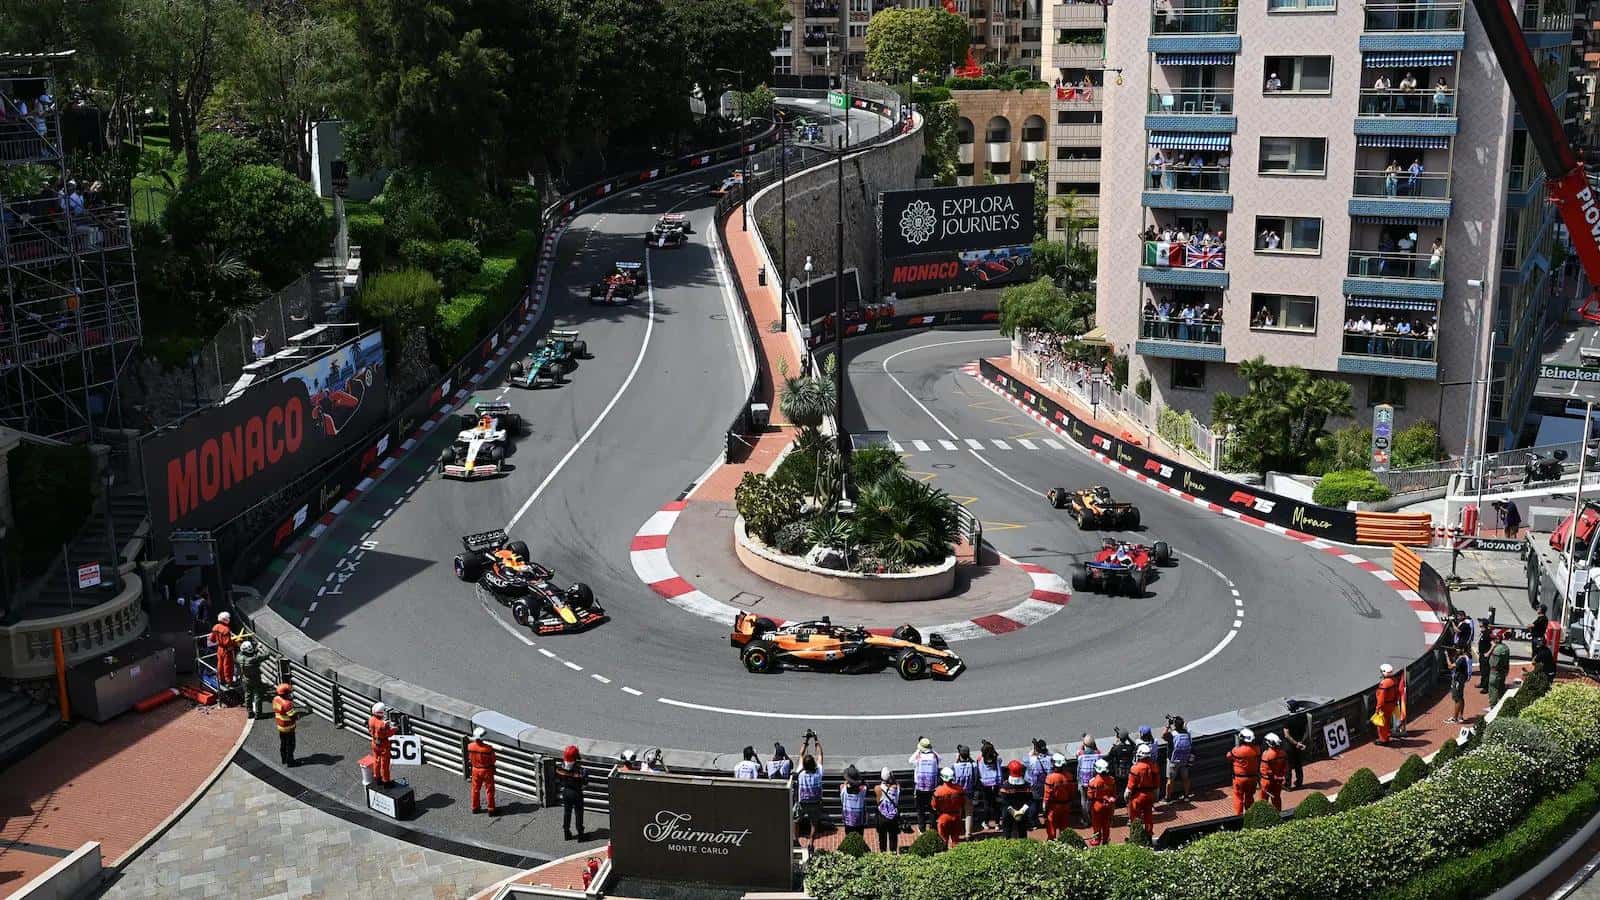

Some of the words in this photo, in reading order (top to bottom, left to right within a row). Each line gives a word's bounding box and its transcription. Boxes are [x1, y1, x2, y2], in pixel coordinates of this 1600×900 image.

[942, 195, 1015, 216] EXPLORA
[939, 213, 1020, 240] JOURNEYS
[1576, 186, 1600, 251] PIOV
[892, 261, 959, 283] MONACO
[167, 396, 304, 523] MONACO
[1292, 506, 1332, 530] Monaco
[786, 626, 818, 634] chrome
[1327, 724, 1346, 750] SC
[390, 739, 417, 761] SC
[643, 810, 752, 847] Fairmont
[668, 844, 698, 854] MONTE
[701, 846, 729, 856] CARLO
